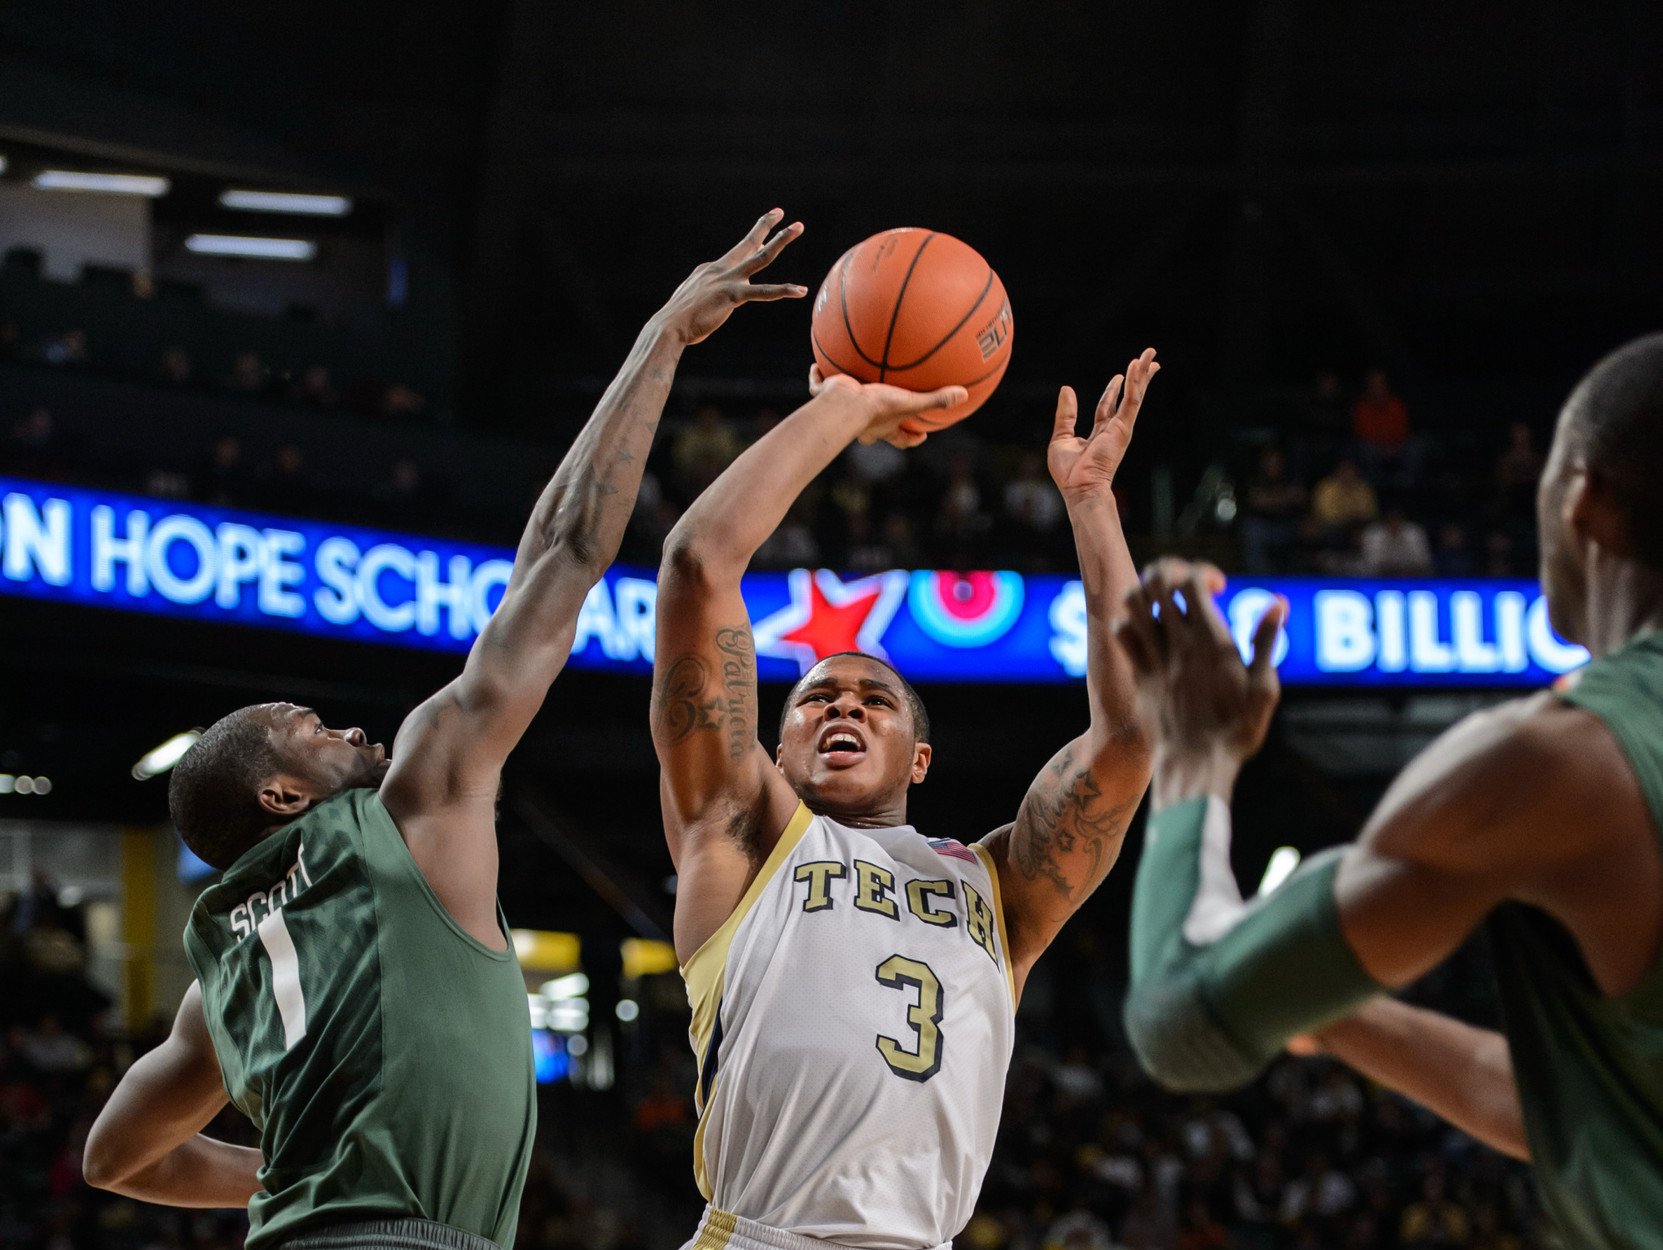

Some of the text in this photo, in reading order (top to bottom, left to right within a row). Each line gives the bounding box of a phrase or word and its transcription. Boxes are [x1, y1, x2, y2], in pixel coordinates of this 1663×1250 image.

[0, 491, 657, 664] N HOPE SCHOAR
[1314, 588, 1592, 675] BILLIO
[257, 906, 307, 1052] 1
[793, 859, 1001, 974] TECH
[875, 953, 945, 1084] 3
